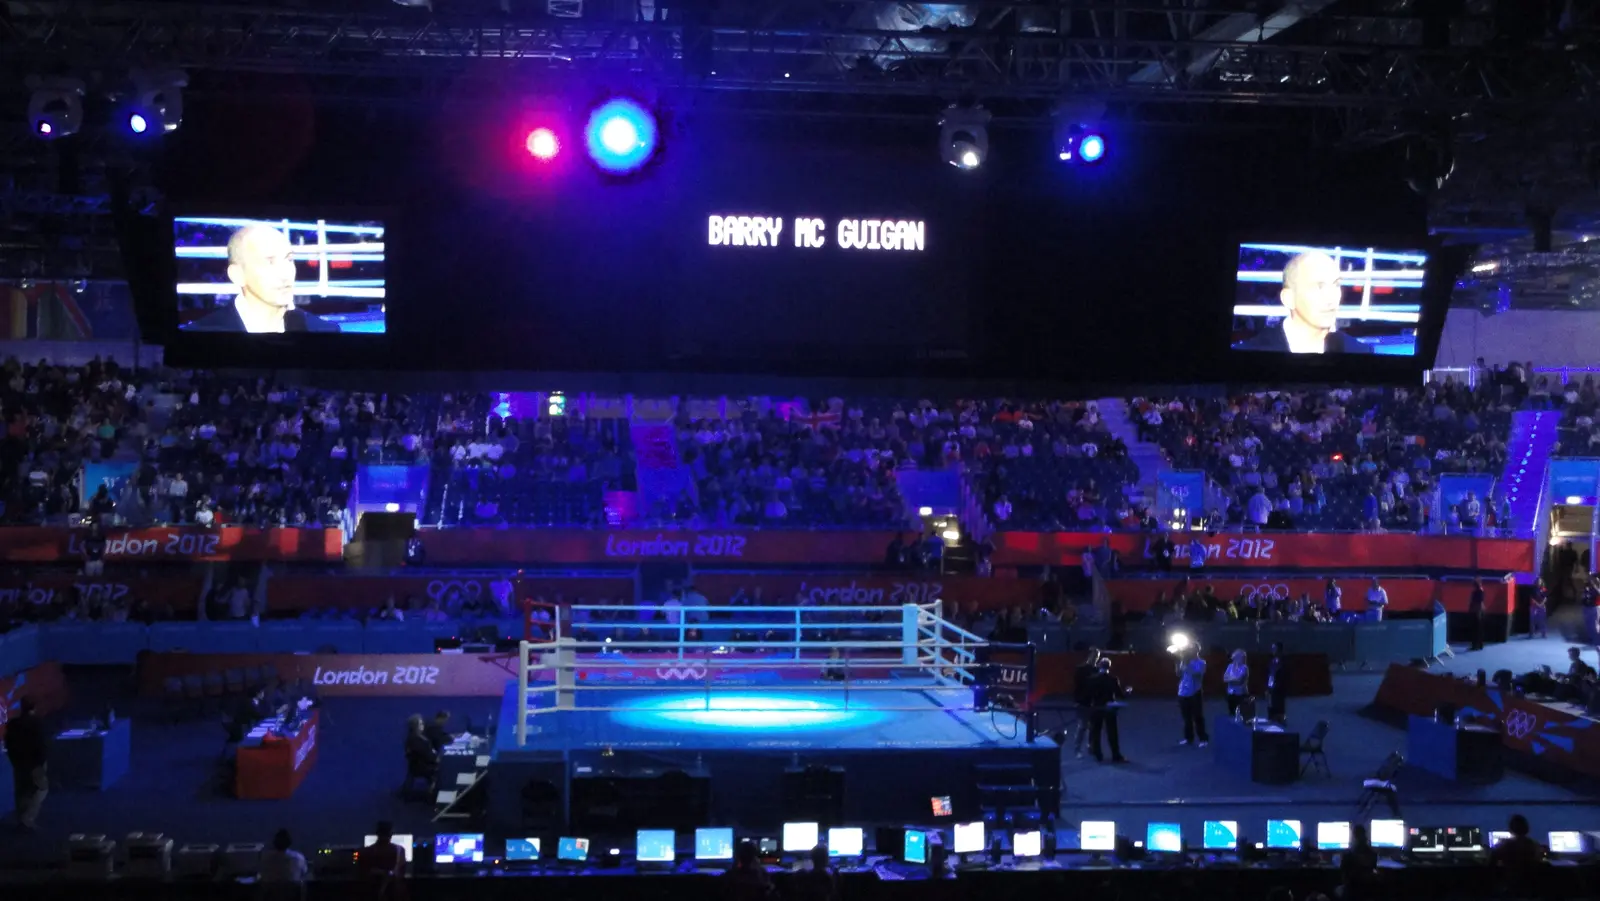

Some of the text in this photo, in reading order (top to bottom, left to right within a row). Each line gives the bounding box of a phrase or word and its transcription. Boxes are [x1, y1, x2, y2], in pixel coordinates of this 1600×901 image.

[708, 215, 925, 251] BARRY MC GUIGAN
[164, 533, 220, 555] 2012
[605, 534, 747, 557] London 2012
[1225, 538, 1275, 559] 2012
[313, 665, 440, 685] London 2012
